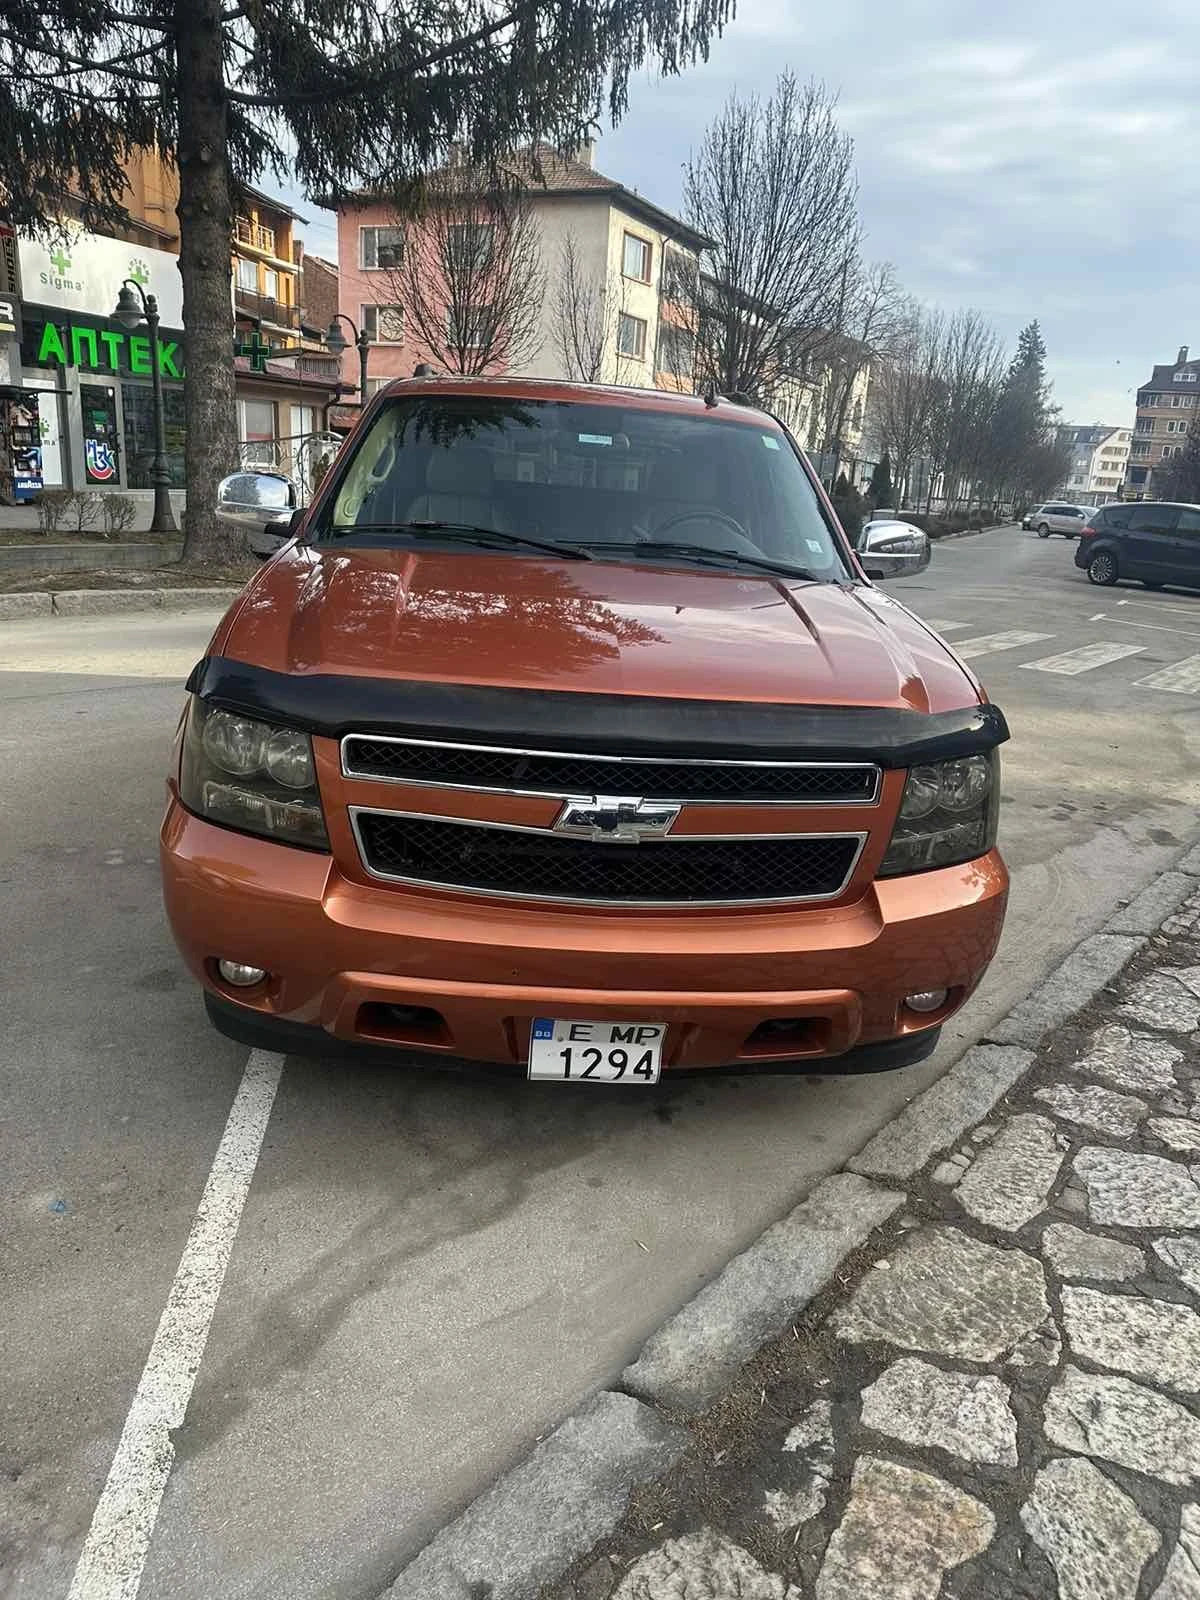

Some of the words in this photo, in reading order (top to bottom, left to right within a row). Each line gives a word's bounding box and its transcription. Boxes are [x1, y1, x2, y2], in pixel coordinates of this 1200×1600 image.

[40, 272, 82, 291] Sigma
[38, 321, 187, 378] АПТЕК
[569, 1024, 594, 1042] E
[610, 1026, 660, 1045] MP
[560, 1047, 654, 1080] 1294
